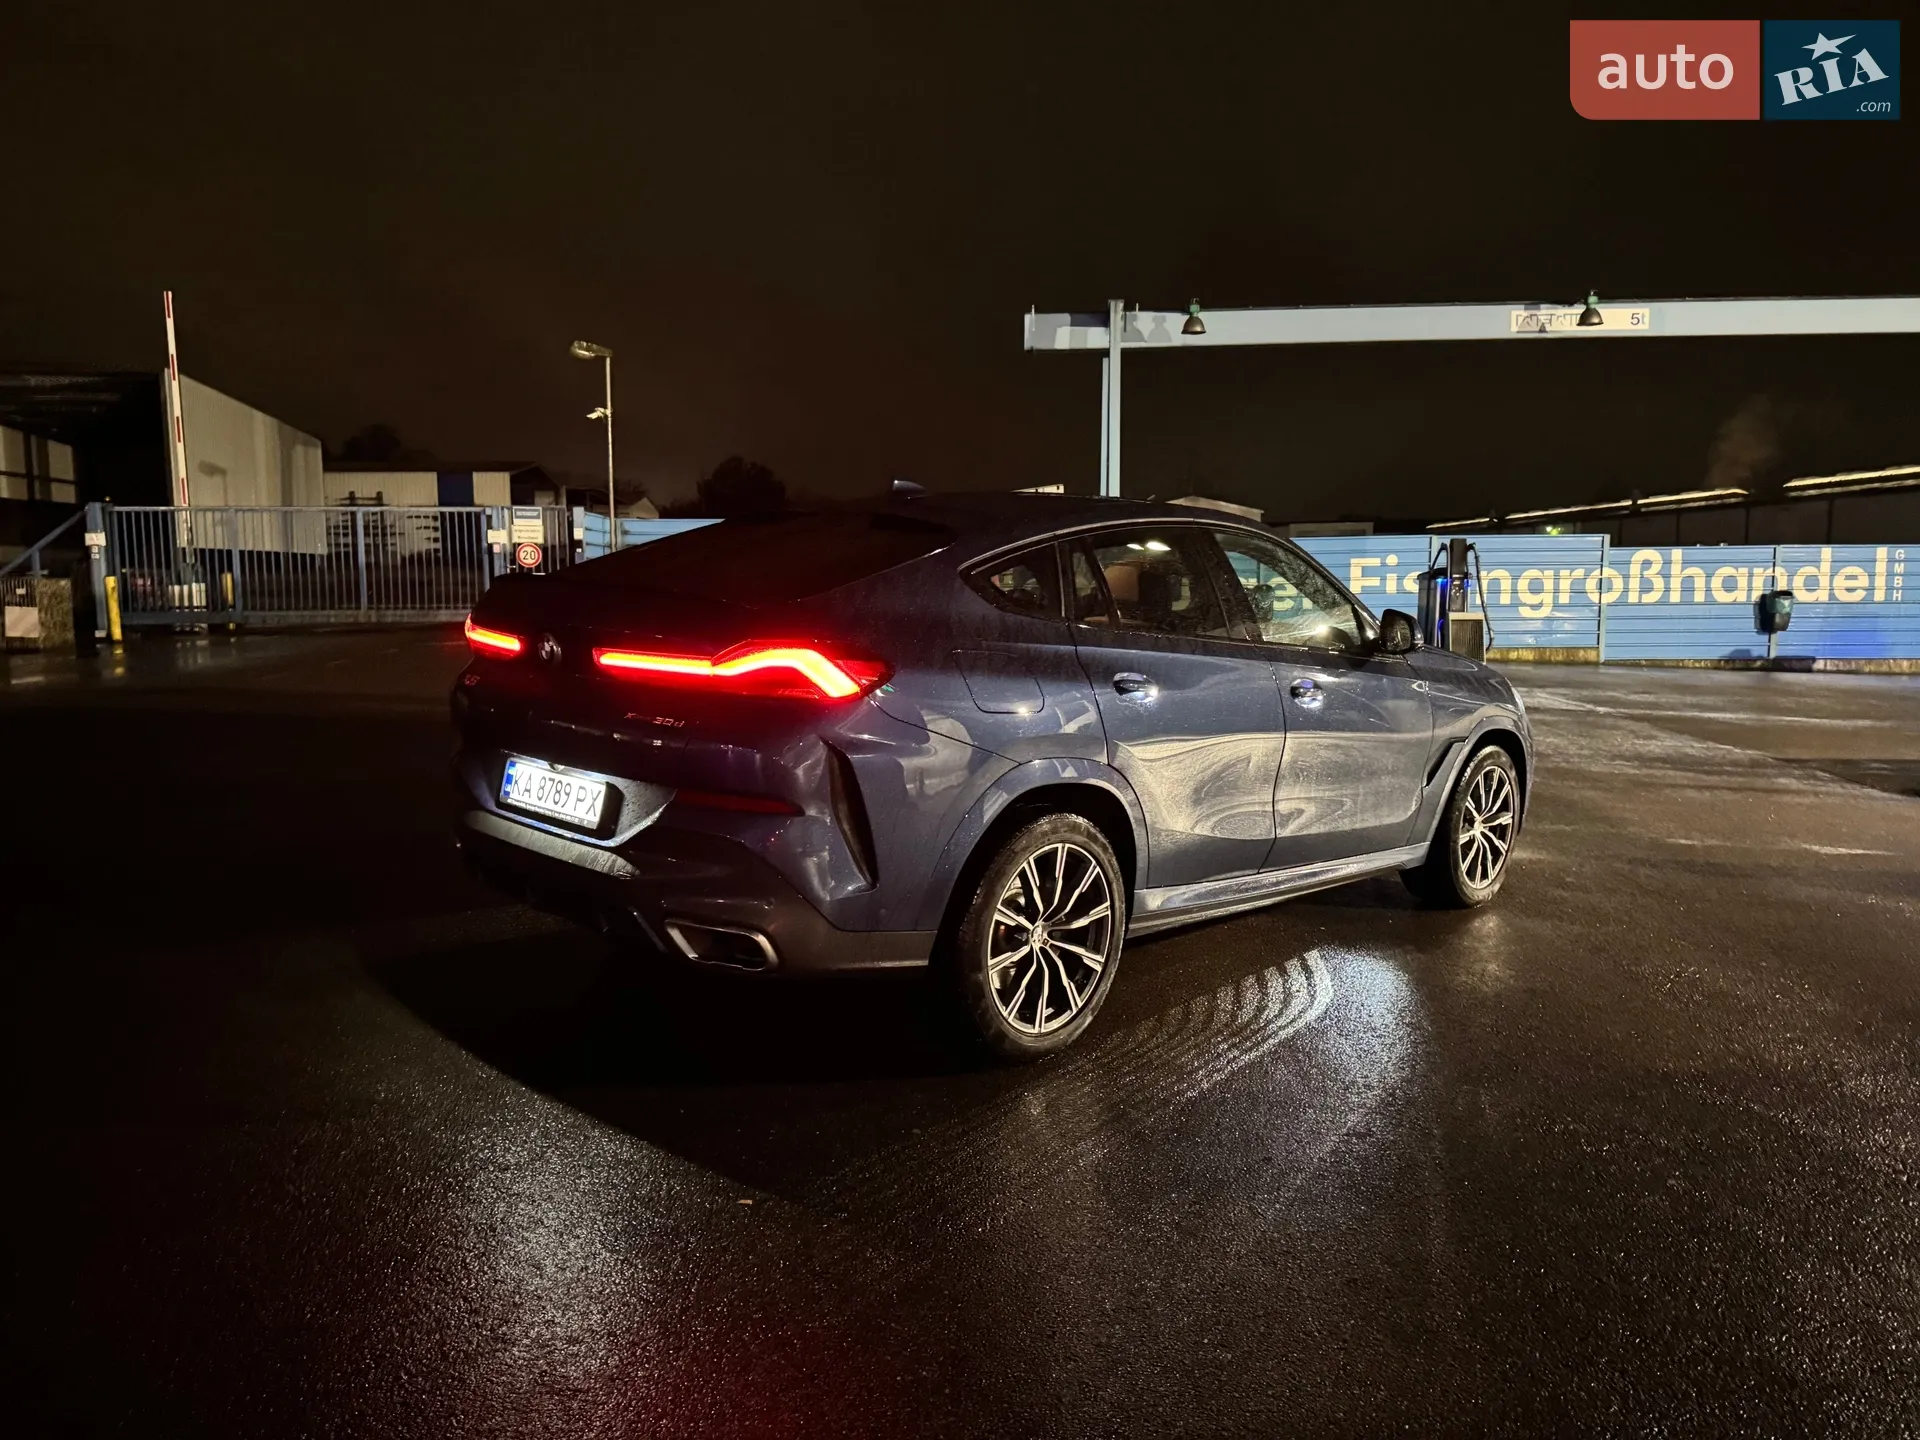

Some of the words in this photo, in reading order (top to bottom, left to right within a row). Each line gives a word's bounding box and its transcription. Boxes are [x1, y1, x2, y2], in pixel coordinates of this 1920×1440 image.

[522, 550, 536, 561] 20
[1893, 549, 1906, 601] GMBH
[511, 768, 532, 799] KA
[537, 776, 572, 808] 8789
[573, 785, 602, 818] PX
